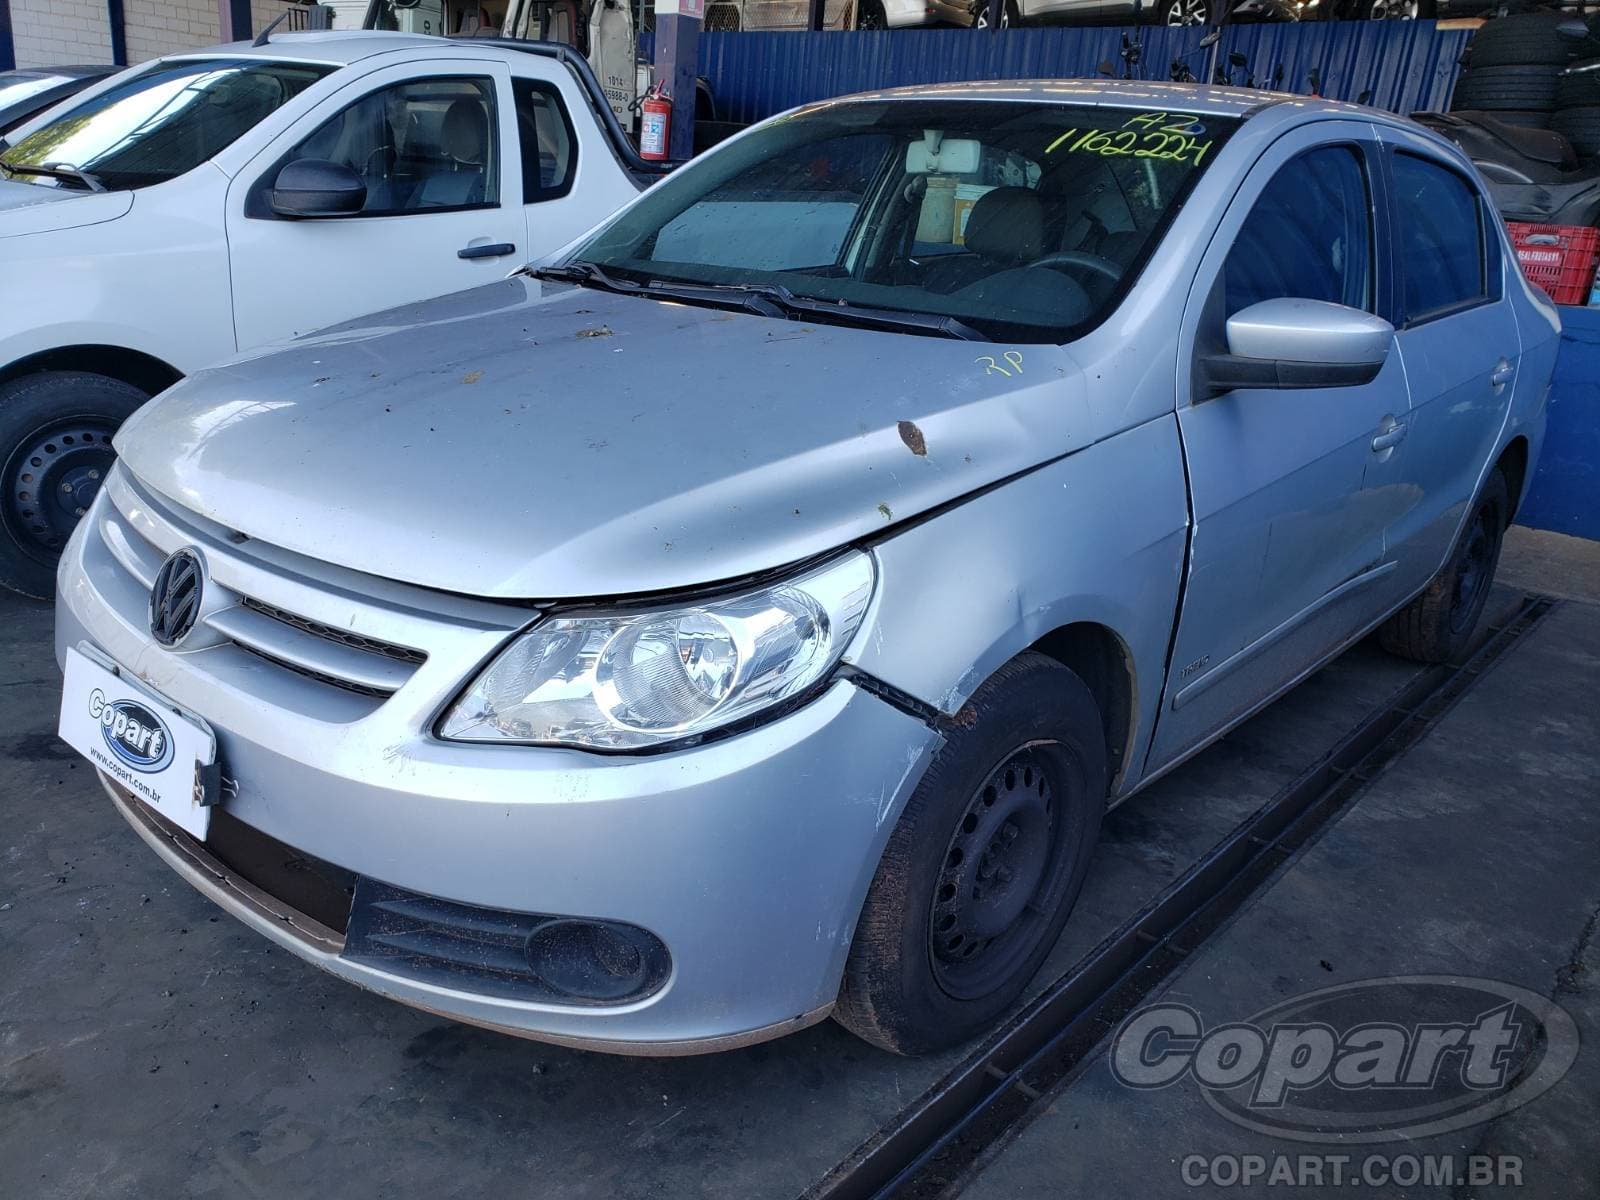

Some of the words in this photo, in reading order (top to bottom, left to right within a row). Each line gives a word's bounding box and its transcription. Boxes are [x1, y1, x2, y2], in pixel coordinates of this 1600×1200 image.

[1045, 128, 1213, 167] 1162224
[89, 688, 164, 759] Copart
[90, 746, 161, 803] www.copart.com.br
